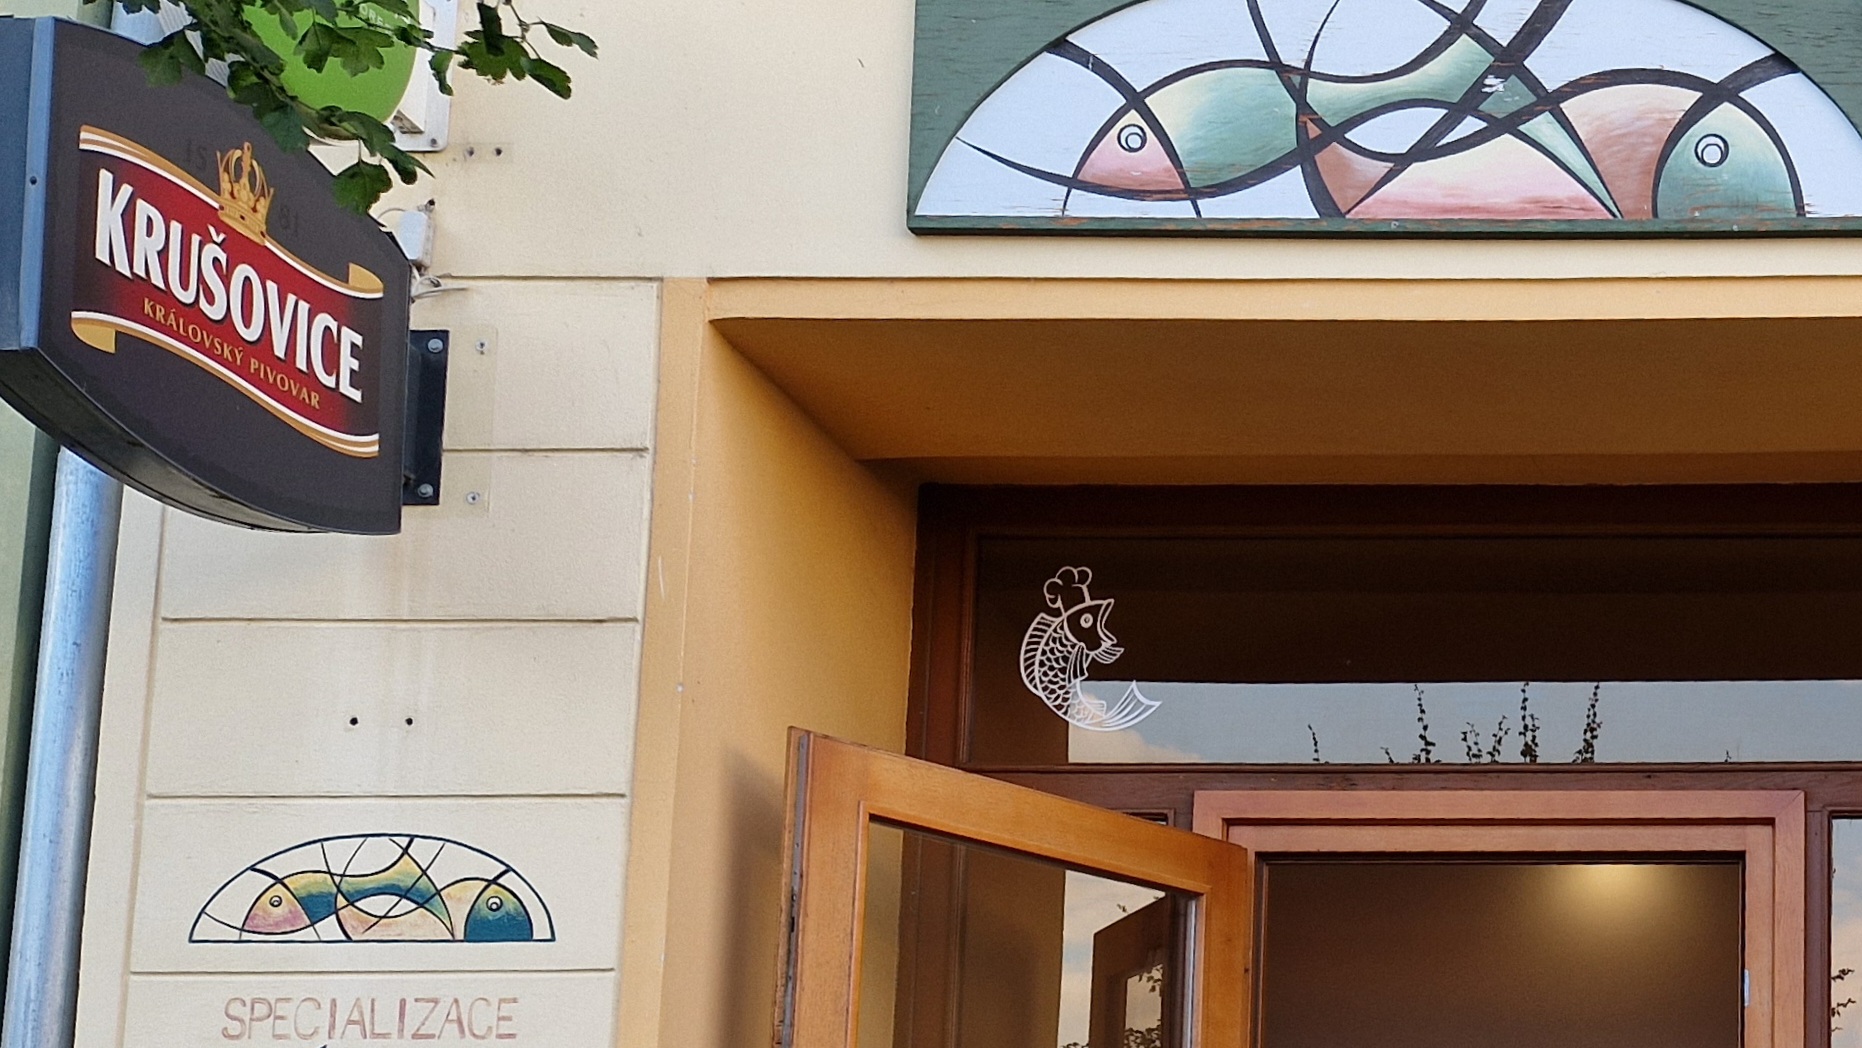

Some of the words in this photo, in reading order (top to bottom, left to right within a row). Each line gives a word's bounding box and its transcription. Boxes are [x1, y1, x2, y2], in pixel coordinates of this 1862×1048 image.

[95, 168, 364, 403] KRUŠOVICE
[143, 297, 244, 367] KRÁLOVSKÝ
[249, 358, 321, 410] PIVOVAR
[221, 996, 519, 1041] SPECIALIZACE
